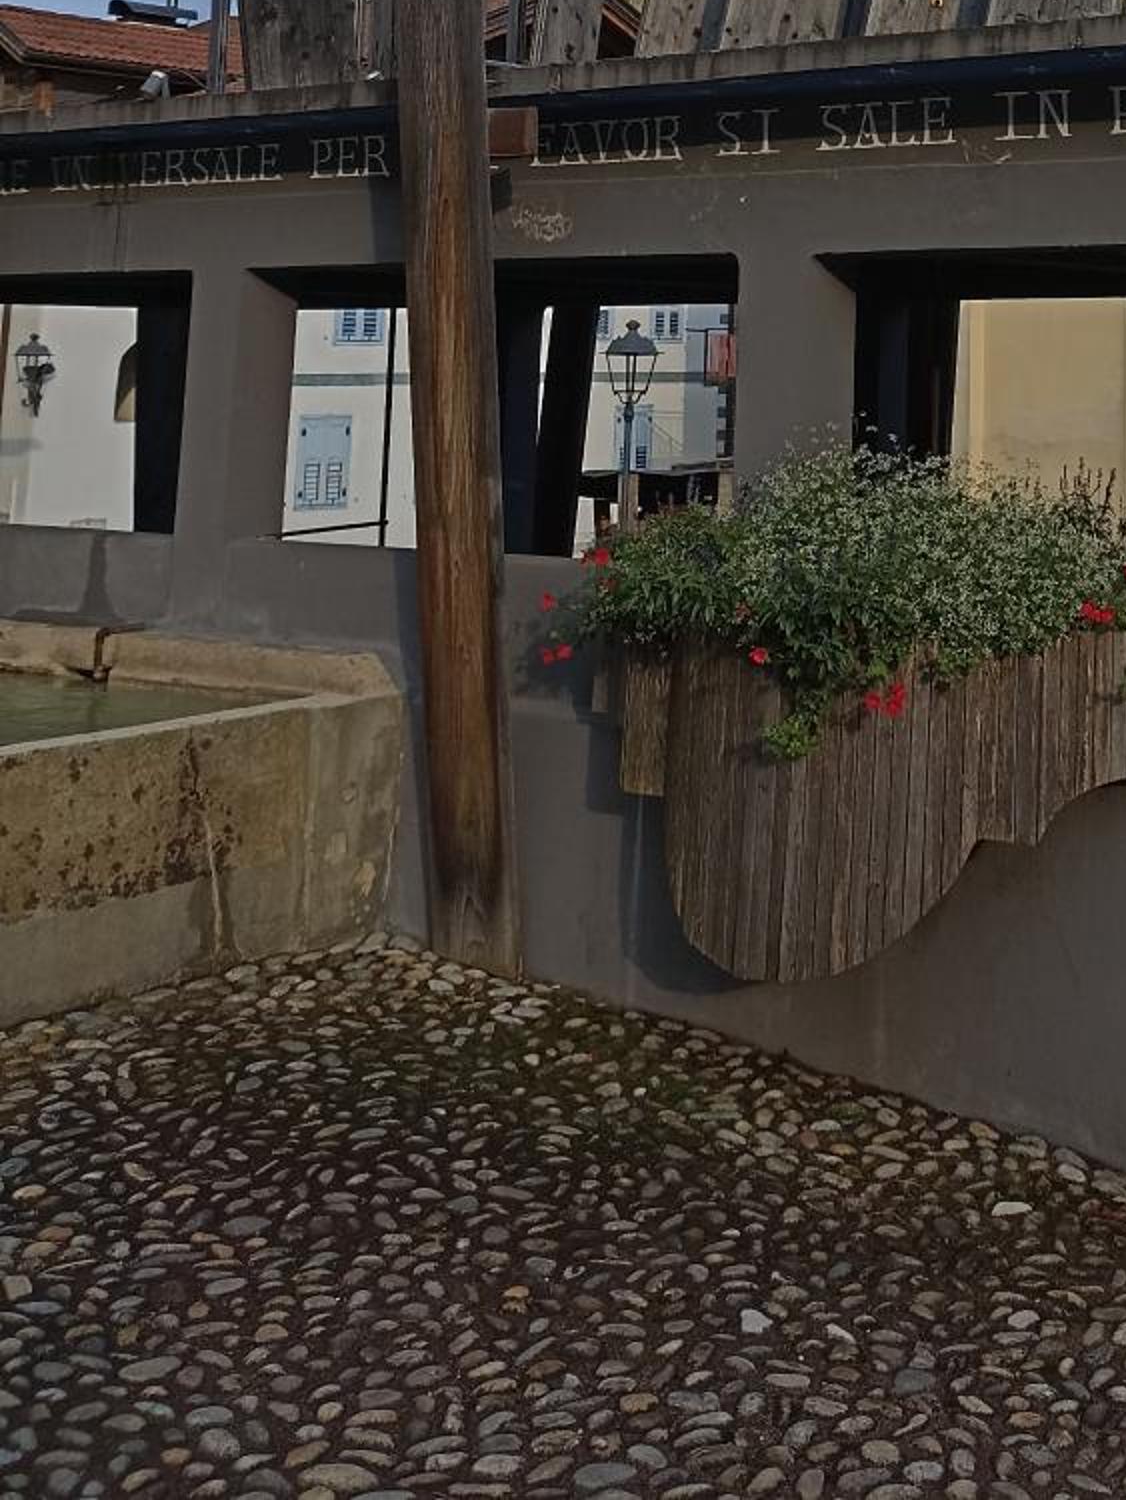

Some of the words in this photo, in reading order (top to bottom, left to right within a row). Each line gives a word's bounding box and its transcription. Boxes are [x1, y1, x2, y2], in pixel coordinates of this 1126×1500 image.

[308, 135, 391, 180] PER
[715, 108, 782, 156] SI
[815, 97, 957, 151] SALE
[992, 89, 1073, 141] IN
